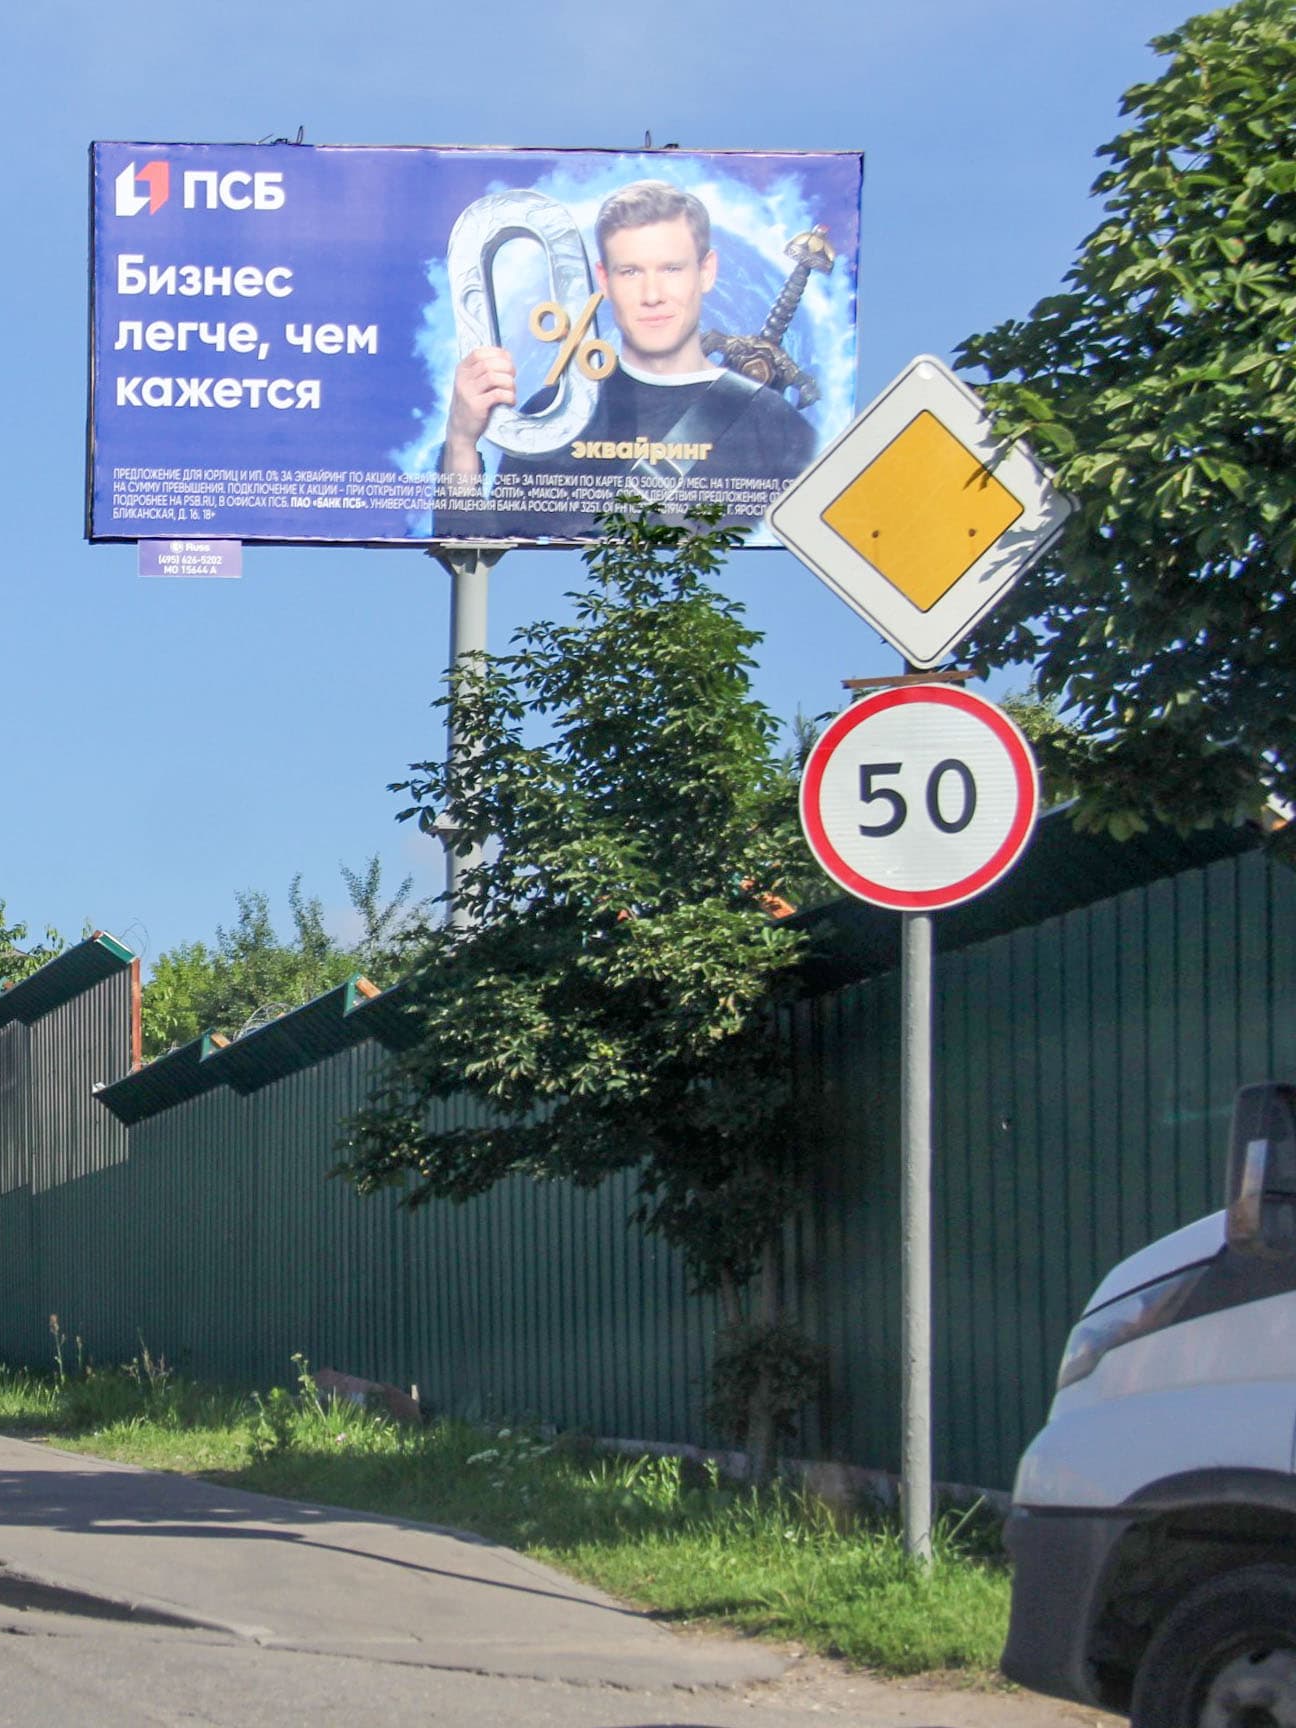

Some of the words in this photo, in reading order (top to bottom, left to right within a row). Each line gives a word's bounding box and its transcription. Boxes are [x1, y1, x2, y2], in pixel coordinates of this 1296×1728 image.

[184, 171, 285, 210] ПСБ
[118, 254, 294, 298] Бизнес
[114, 320, 270, 360] легче,
[285, 323, 378, 354] чем
[116, 376, 321, 409] кажется
[571, 437, 712, 464] эквайринг
[113, 468, 181, 481] ПРЕДЛОЖЕНИЕ
[183, 469, 202, 481] ДЛЯ
[204, 469, 238, 482] ЮРЛИЦ
[240, 470, 246, 480] И
[281, 470, 292, 481] ЗА
[294, 469, 347, 482] ЭКВАЙРИНГ
[349, 471, 363, 482] ПО
[365, 472, 395, 484] АКЦИИ
[522, 474, 534, 485] ЗА
[536, 475, 577, 486] ПЛАТЕЖИ
[580, 475, 593, 486] ПО
[596, 476, 624, 487] КАРТЕ
[625, 476, 640, 488] ДО
[710, 478, 724, 489] НА
[725, 478, 730, 489] 1
[731, 478, 781, 491] ТЕРМИНАЛ,
[113, 482, 126, 492] НА
[128, 482, 160, 493] СУММУ
[162, 482, 225, 493] ПРЕВЫШЕНИЯ.
[228, 483, 297, 495] ПОДКЛЮЧЕНИЕ
[299, 484, 305, 494] К
[307, 484, 337, 496] АКЦИИ
[346, 485, 364, 496] ПРИ
[366, 485, 414, 496] ОТКРЫТИИ
[416, 485, 432, 497] Р/С
[434, 486, 445, 497] НА
[447, 486, 489, 498] ТАРИФА
[113, 495, 168, 506] ПОДРОБНЕЕ
[169, 495, 182, 506] НА
[184, 496, 218, 508] PSB.RU,
[219, 496, 225, 506] В
[226, 496, 266, 507] ОФИСАХ
[267, 497, 289, 507] ПСБ.
[291, 497, 311, 508] ПАО
[313, 497, 341, 508] «БАНК
[370, 499, 447, 510] УНИВЕРСАЛЬНАЯ
[448, 499, 495, 512] ЛИЦЕНЗИЯ
[497, 500, 526, 511] БАНКА
[528, 501, 568, 512] РОССИИ
[569, 501, 579, 512] №
[113, 507, 176, 520] БЛИКАНСКАЯ,
[203, 509, 216, 520] 18+
[186, 542, 210, 552] Russ
[859, 758, 977, 838] 50
